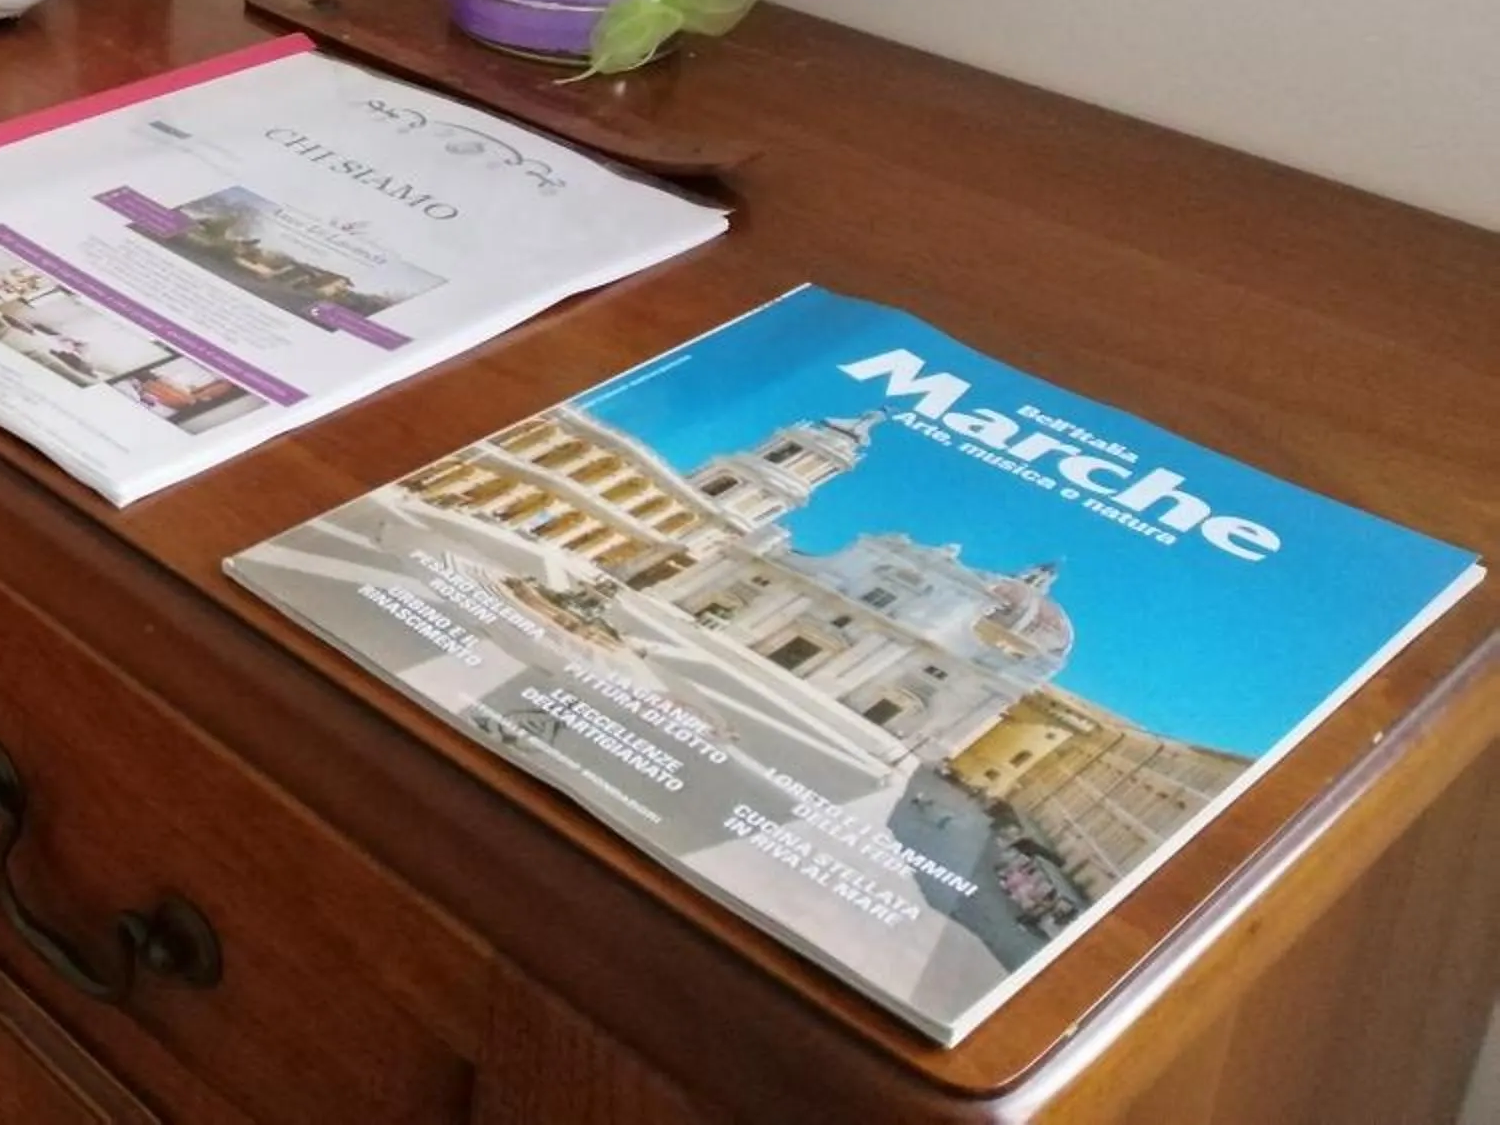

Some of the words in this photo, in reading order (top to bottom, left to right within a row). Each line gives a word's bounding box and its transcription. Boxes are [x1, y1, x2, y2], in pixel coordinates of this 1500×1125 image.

[264, 127, 336, 163] CHI
[329, 159, 460, 220] SIAMO
[836, 347, 1281, 562] Marche
[893, 411, 953, 447] Arte,
[957, 442, 1057, 490] musica
[1081, 497, 1177, 545] natura
[1016, 404, 1140, 464] Bell'Italia
[356, 583, 483, 667] RINASCIMENTO
[387, 585, 452, 631] URBINO
[429, 577, 498, 625] ROSSINI
[550, 688, 578, 708] LE
[573, 701, 685, 774] ECCELLENZE
[563, 661, 642, 714] PITTURA
[640, 707, 666, 727] DI
[664, 722, 729, 765] LOTTO
[632, 686, 715, 733] GRANDE
[733, 803, 813, 857] CUCINA
[813, 851, 922, 921] STELLATA
[764, 767, 844, 818] LORETO
[872, 833, 980, 898] CAMMINI
[790, 802, 858, 848] DELLA
[723, 815, 752, 838] IN
[750, 834, 802, 869] RIVA
[800, 864, 832, 887] AL
[832, 881, 905, 928] MARE
